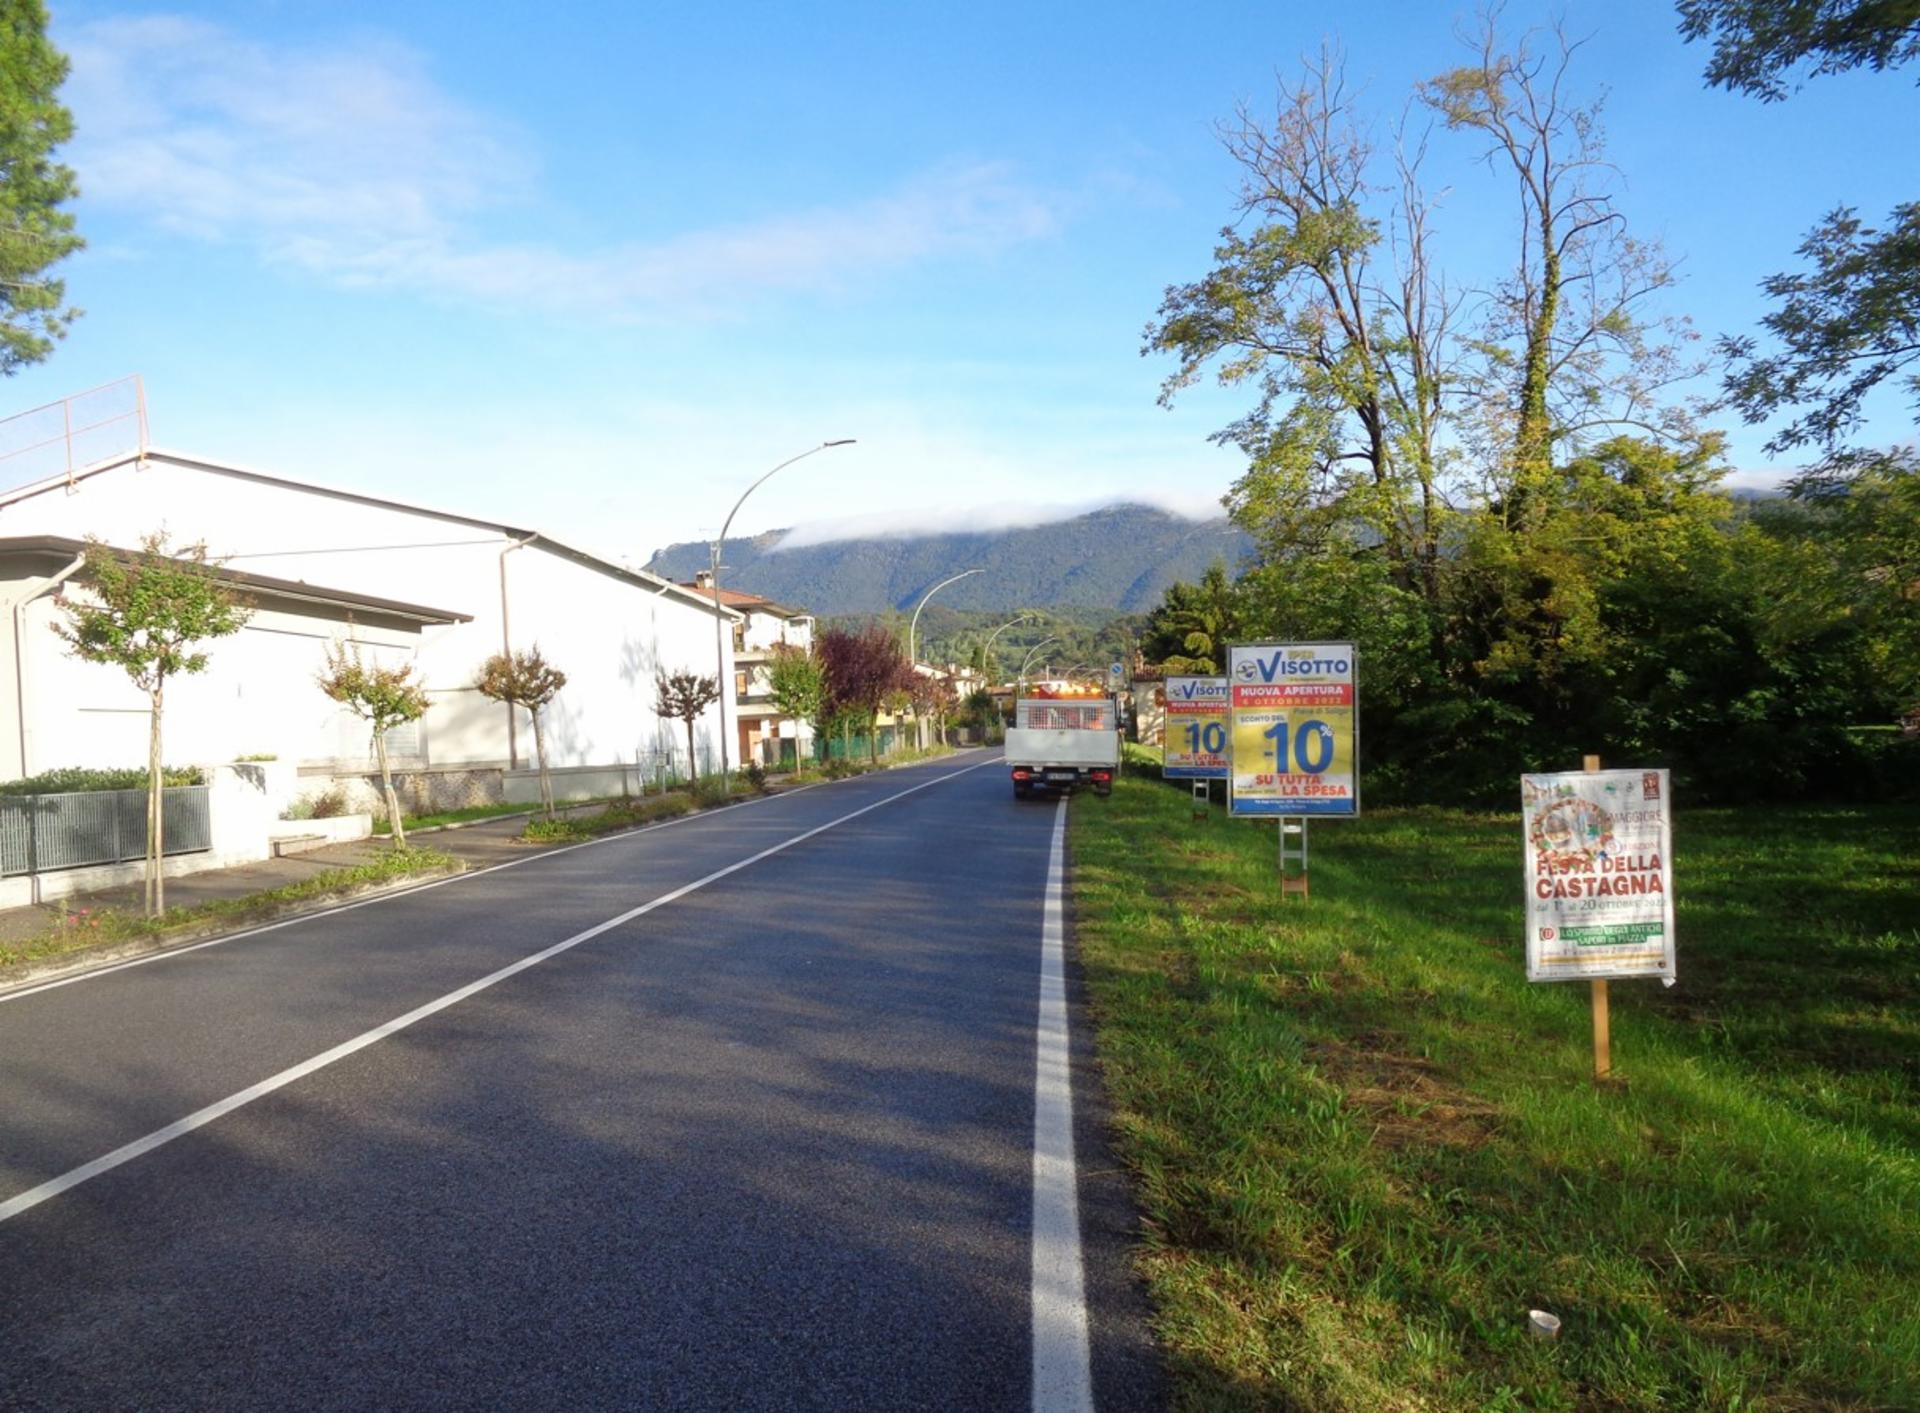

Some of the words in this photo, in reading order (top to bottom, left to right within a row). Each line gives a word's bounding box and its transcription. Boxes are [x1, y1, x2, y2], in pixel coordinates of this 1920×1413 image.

[1257, 651, 1348, 682] VISOTTO
[1182, 681, 1228, 699] VISOTT
[1241, 687, 1280, 696] NUOVA
[1284, 686, 1343, 695] APERTURA
[1254, 697, 1309, 705] OTTOBRE
[1240, 714, 1270, 723] SCONTO
[1256, 774, 1273, 785] SU
[1279, 774, 1321, 785] TUTTA
[1282, 785, 1300, 796] LA
[1303, 785, 1346, 796] SPESA
[1600, 854, 1662, 873] DELLA
[1536, 873, 1663, 899] CASTAGNA
[1580, 900, 1596, 911] 20
